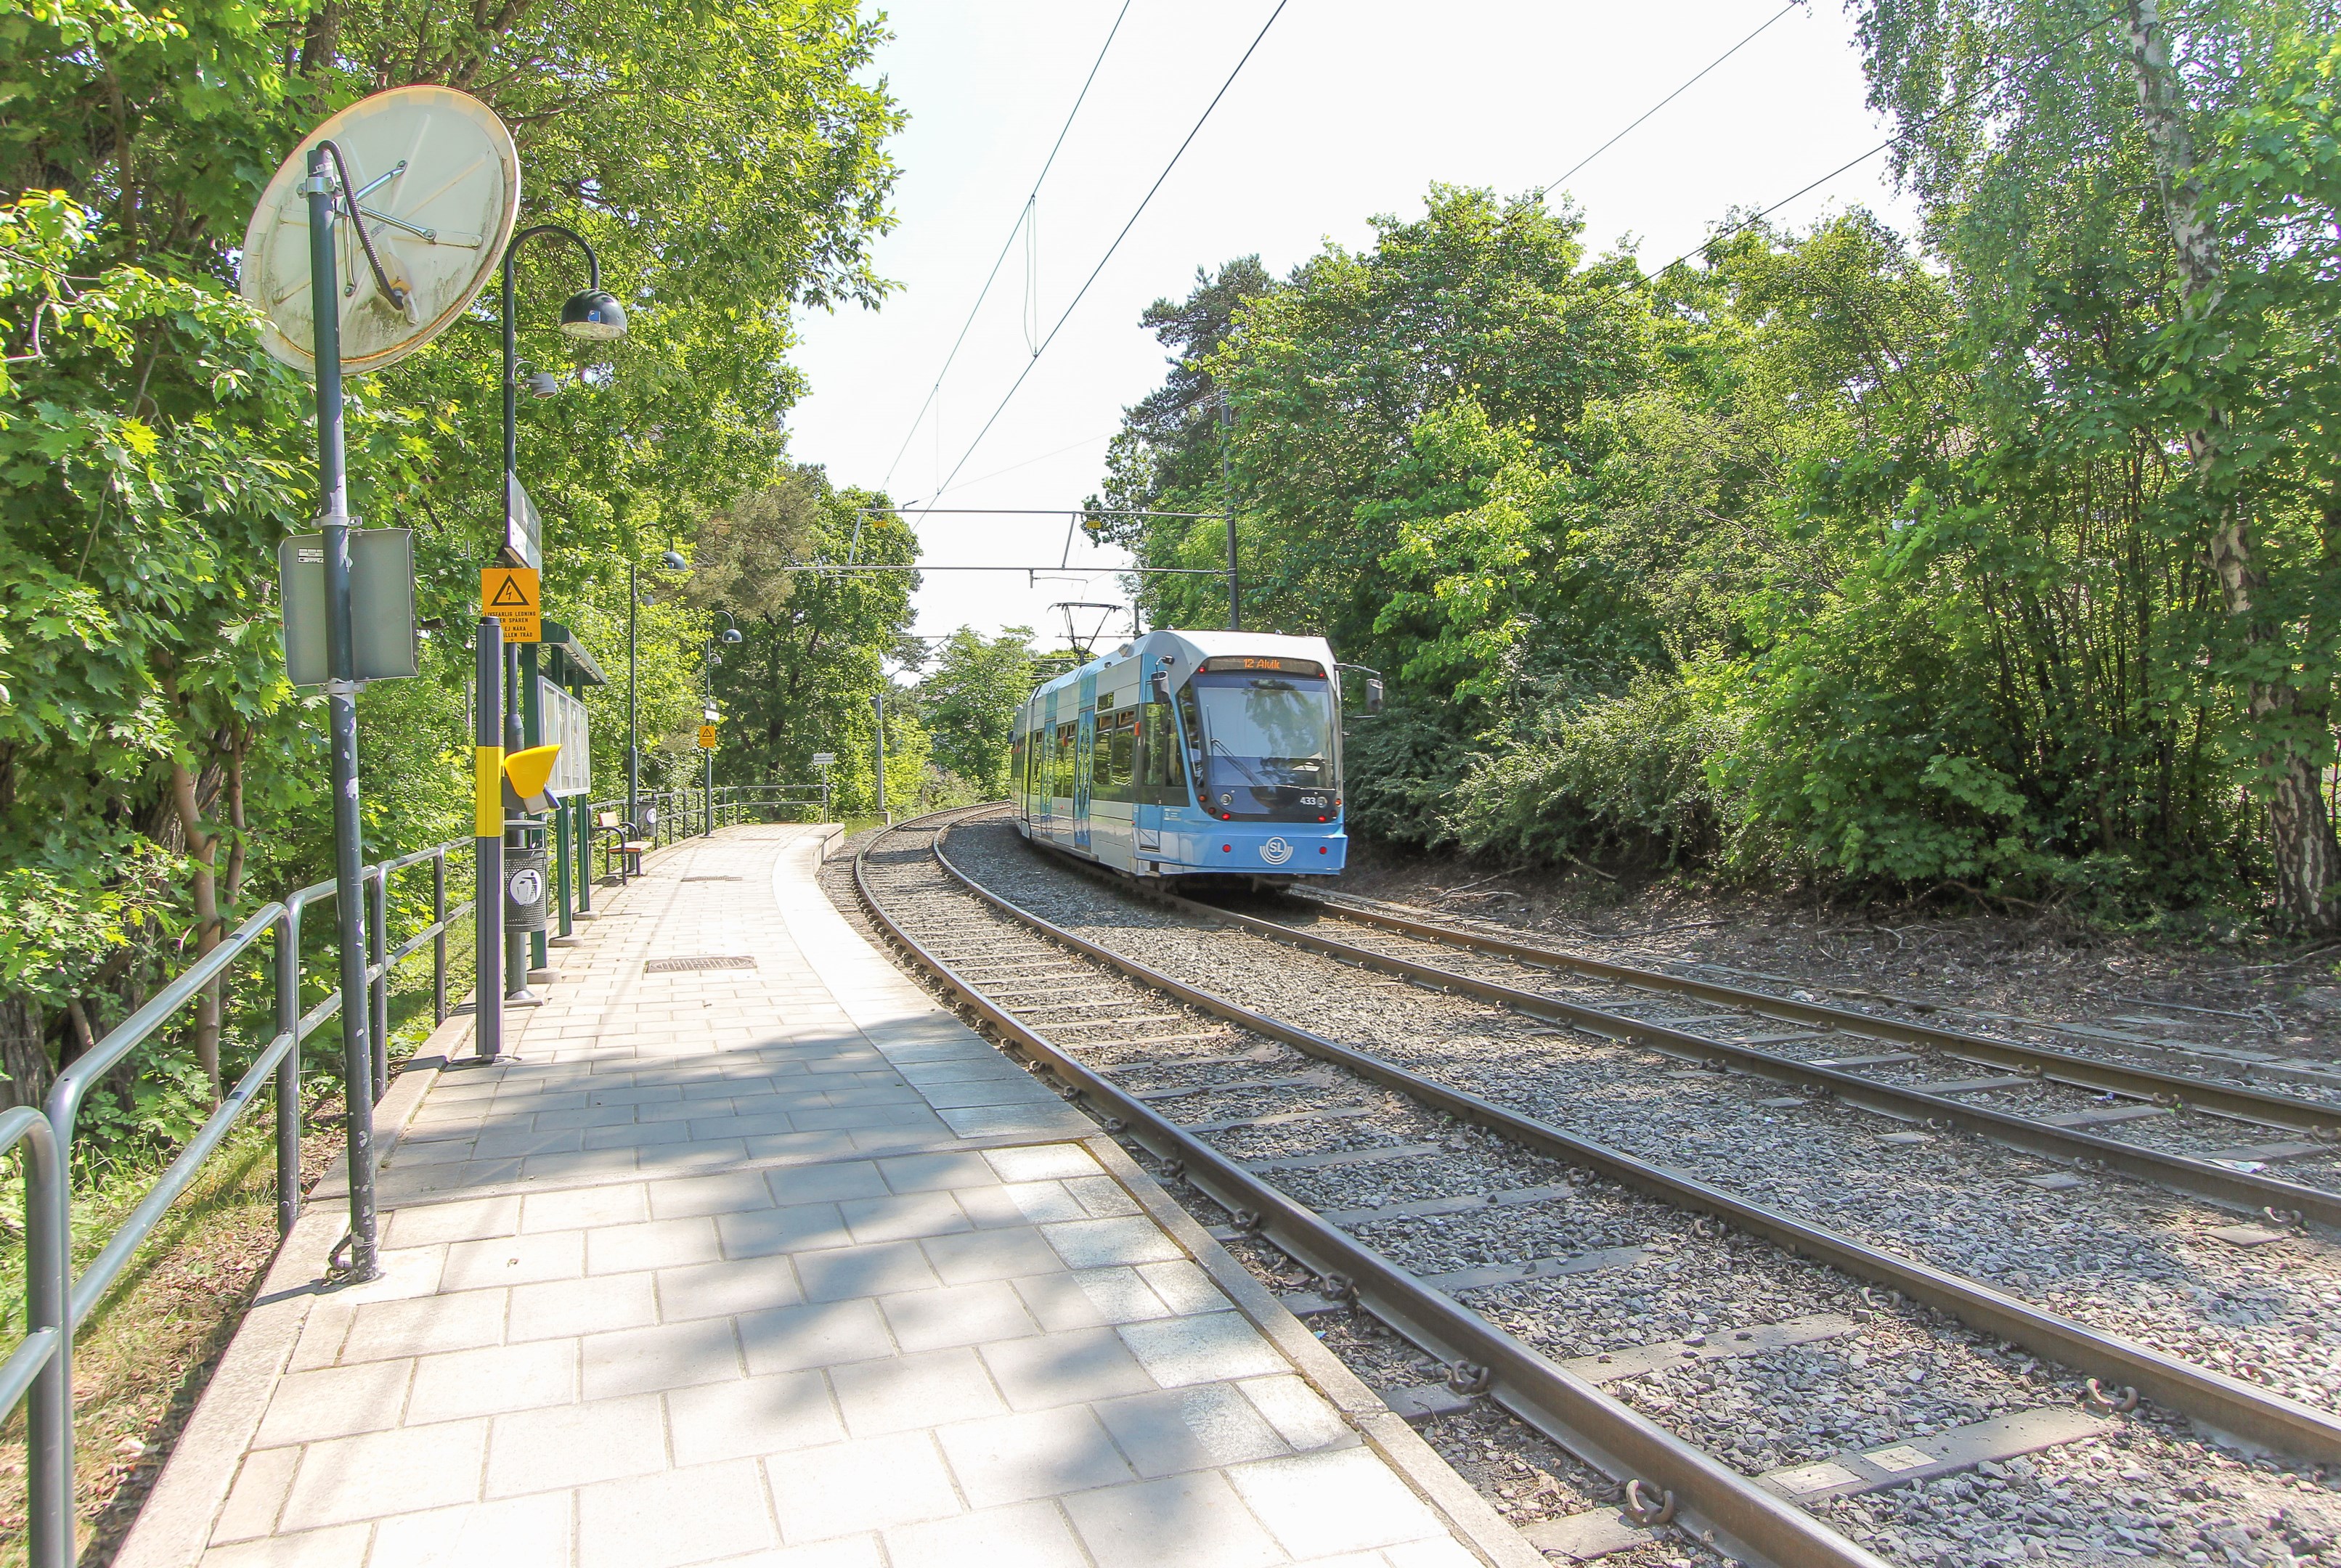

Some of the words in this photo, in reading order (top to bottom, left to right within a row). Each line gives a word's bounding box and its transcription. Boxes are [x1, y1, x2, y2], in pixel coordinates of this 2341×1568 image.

[1243, 658, 1255, 668] 12
[1256, 658, 1281, 669] Alvik
[1300, 796, 1316, 805] 433
[1269, 842, 1284, 853] SL
